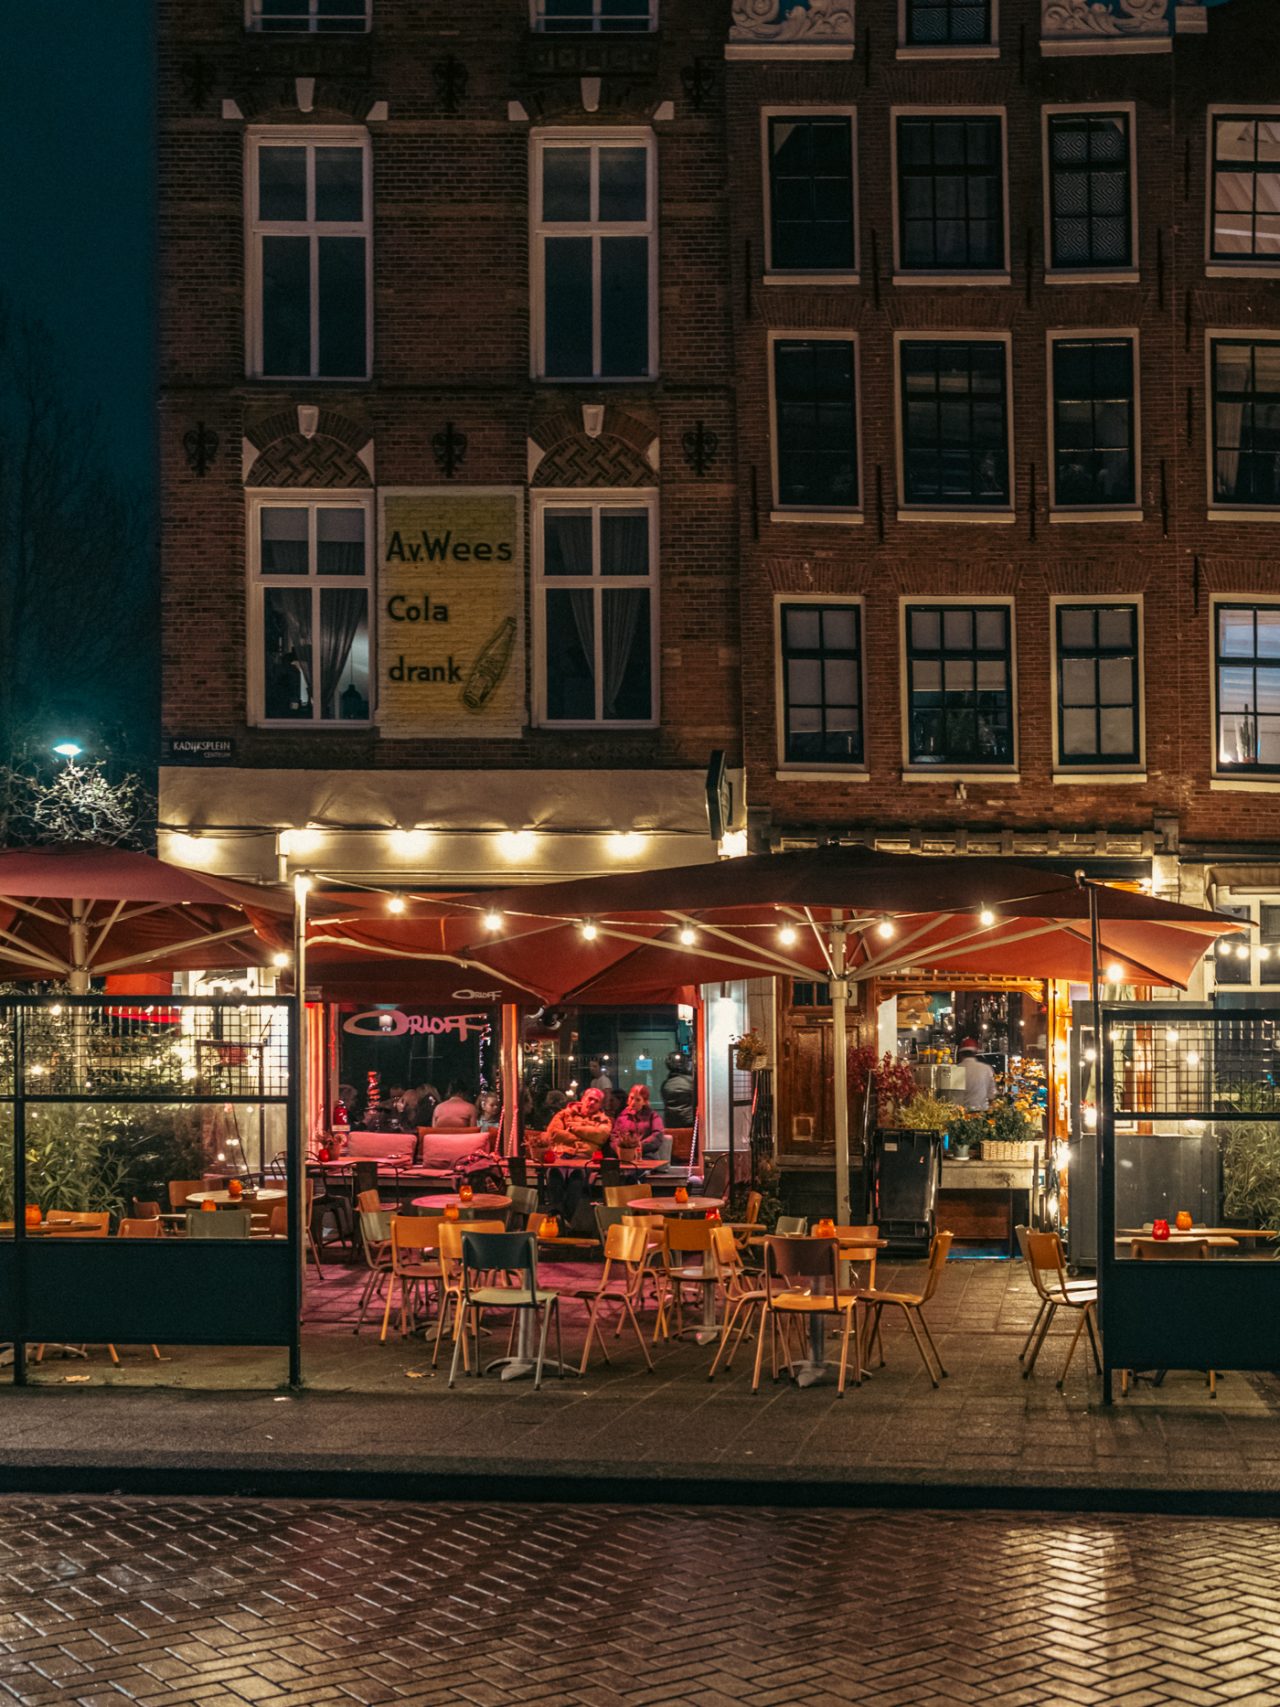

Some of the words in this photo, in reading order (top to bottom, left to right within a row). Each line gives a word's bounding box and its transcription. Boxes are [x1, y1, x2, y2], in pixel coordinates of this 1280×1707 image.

[387, 595, 449, 622] Cola
[388, 655, 463, 684] drank
[343, 1008, 489, 1043] ORLOFF
